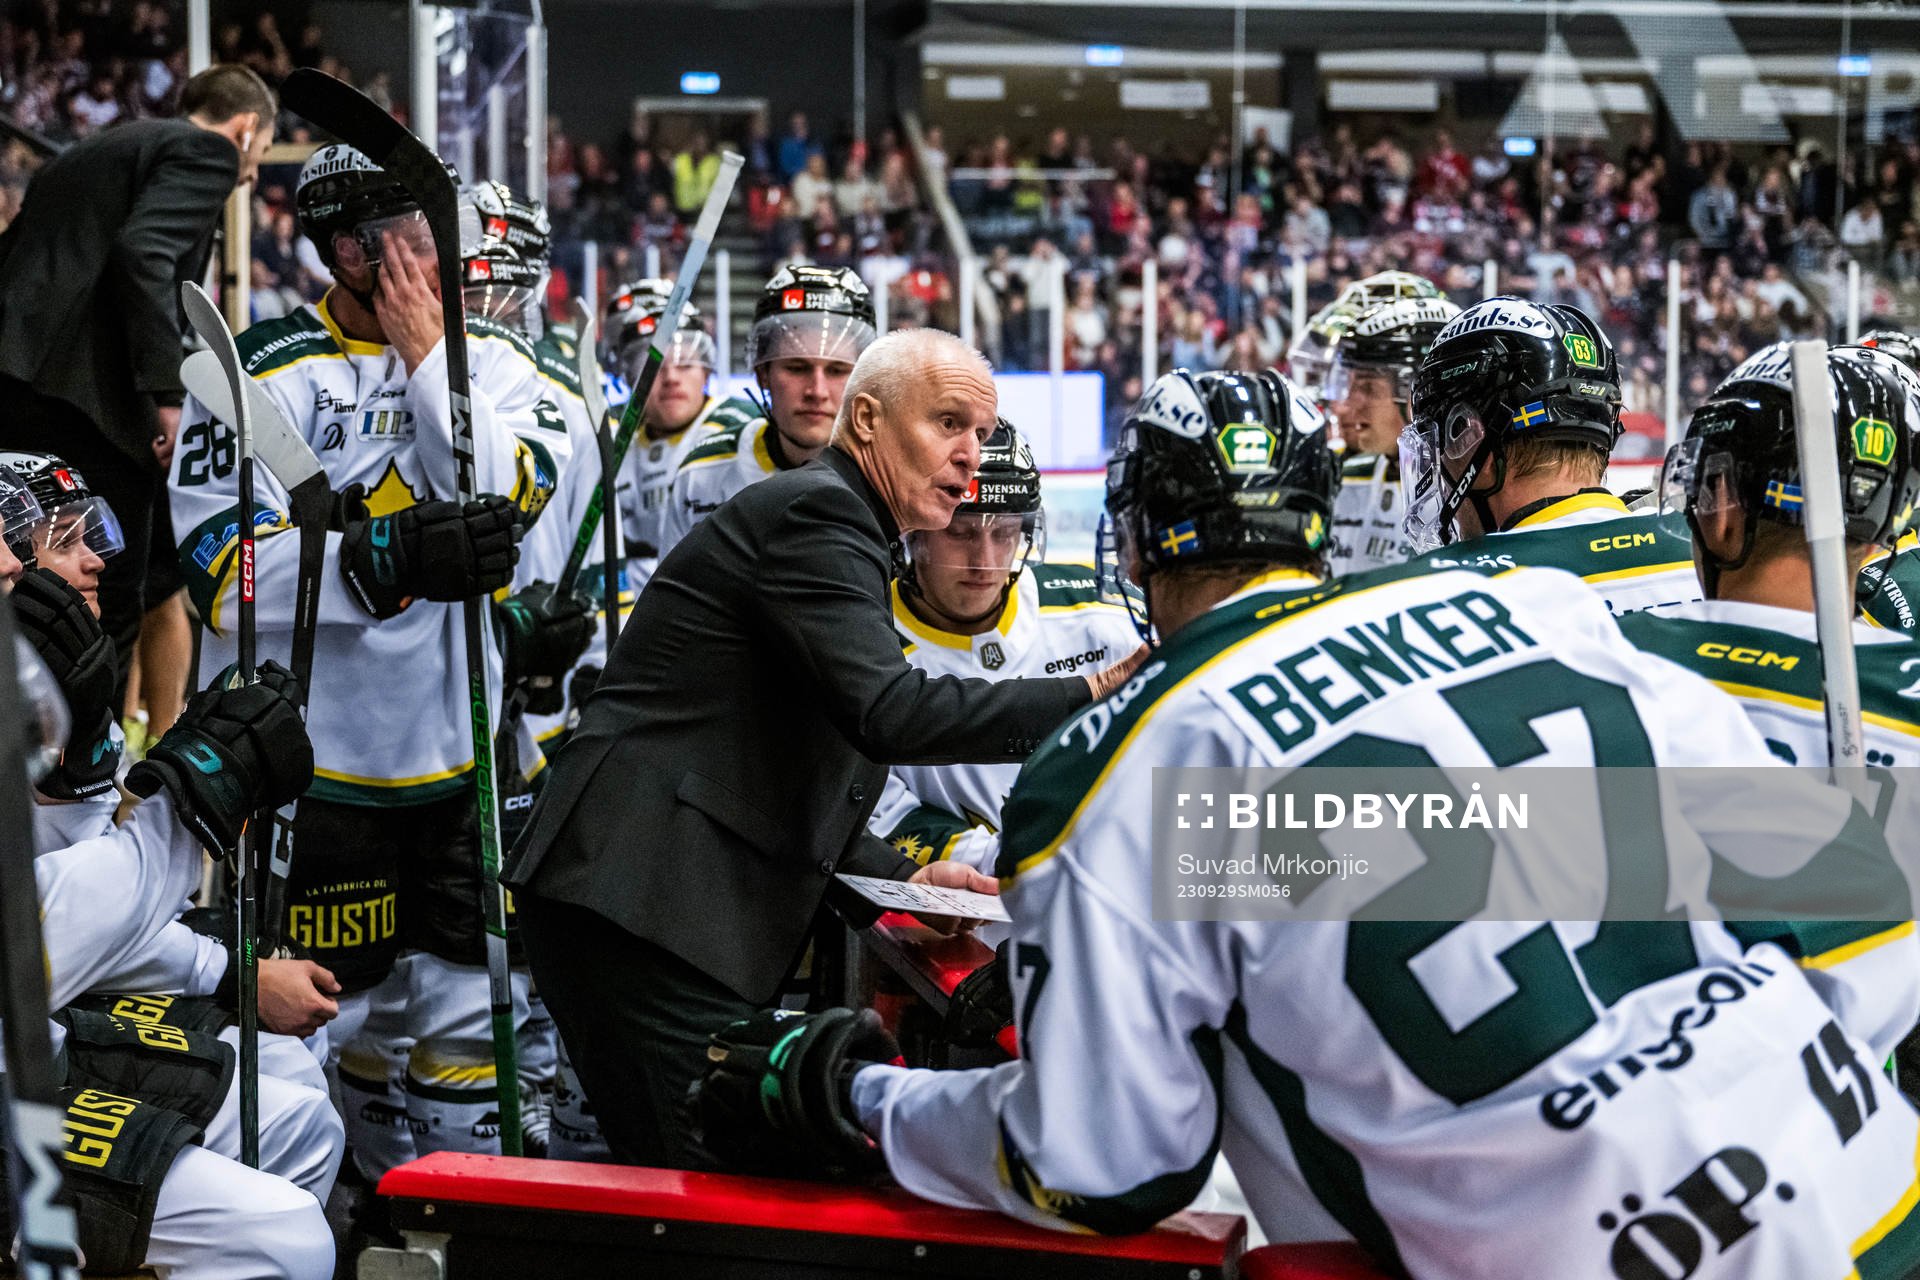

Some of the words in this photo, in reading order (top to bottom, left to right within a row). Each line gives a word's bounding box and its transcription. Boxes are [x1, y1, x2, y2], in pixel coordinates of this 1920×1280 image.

[1572, 338, 1591, 361] 63
[178, 415, 237, 487] 28
[1864, 427, 1885, 457] 10
[981, 484, 1028, 494] SVENSKA
[981, 494, 1007, 503] SPEL
[1449, 464, 1477, 509] CCM
[1590, 533, 1656, 552] CCM
[243, 543, 254, 598] CCM
[1228, 590, 1539, 753] BENKER
[1696, 642, 1800, 671] CCM
[472, 702, 499, 883] JETSPEED
[306, 887, 319, 897] LA
[373, 879, 388, 889] DEL
[1258, 657, 1700, 1107] 27
[289, 892, 396, 949] GUSTO
[1539, 961, 1777, 1131] engcon
